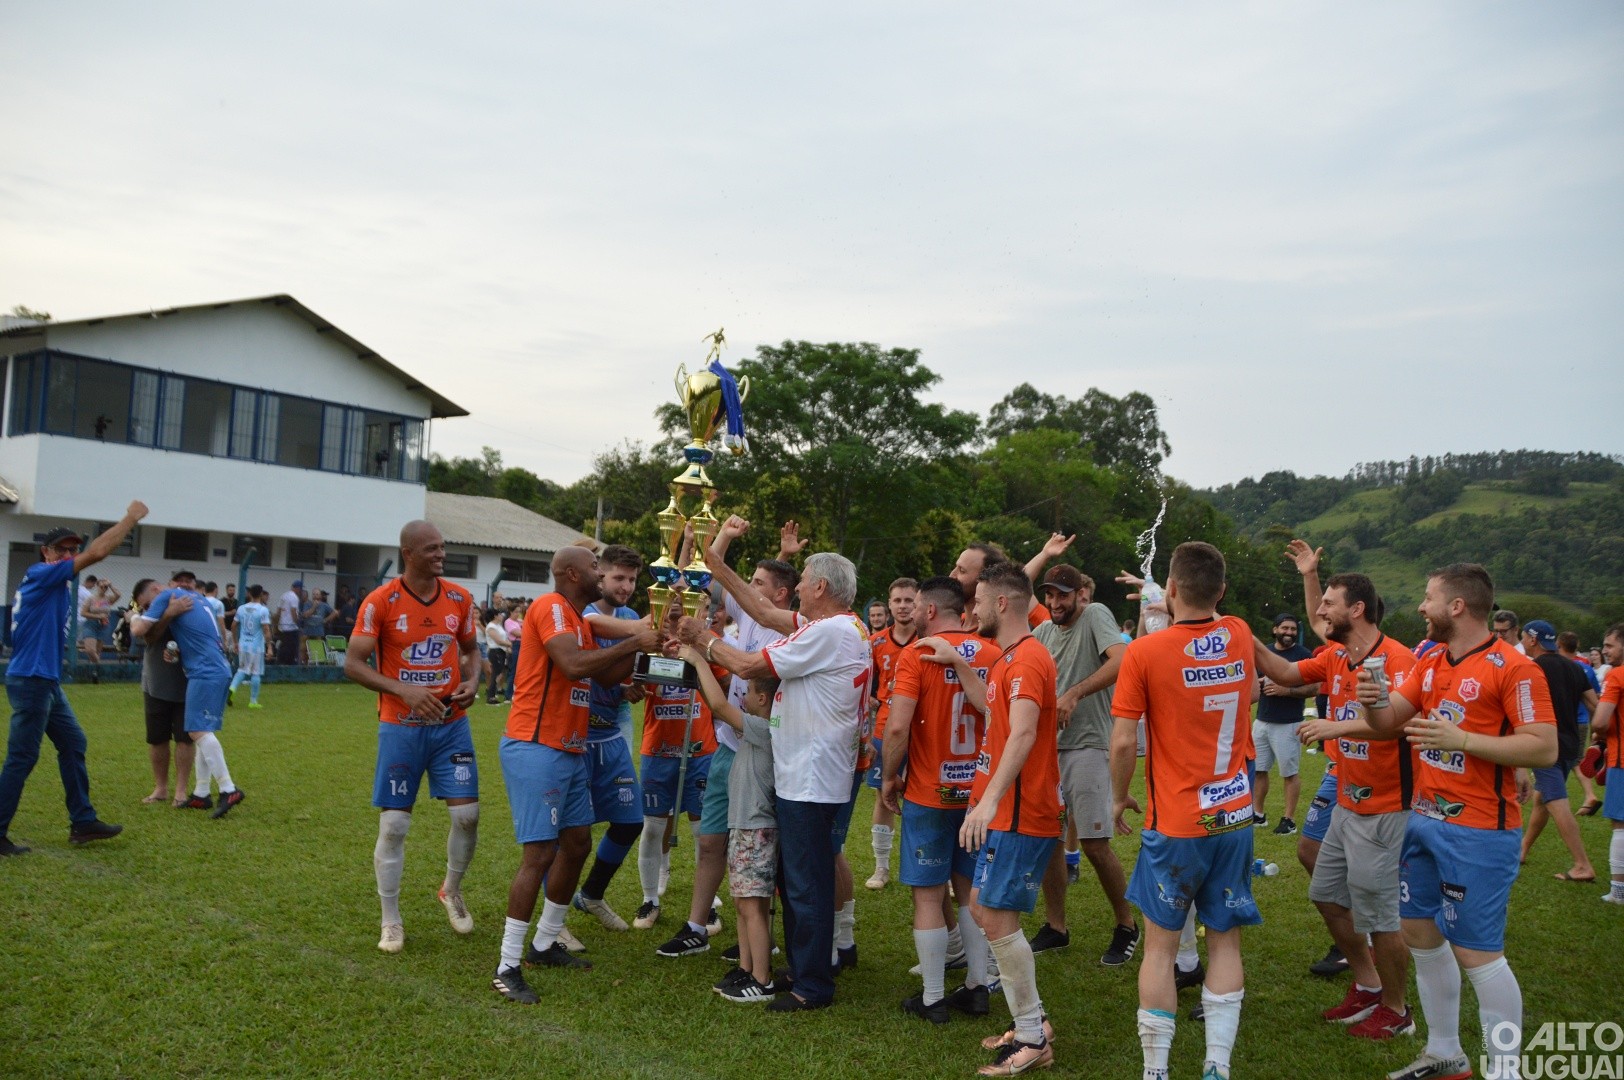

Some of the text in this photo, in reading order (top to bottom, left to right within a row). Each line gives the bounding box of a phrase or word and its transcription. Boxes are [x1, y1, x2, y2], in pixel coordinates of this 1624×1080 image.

[882, 654, 891, 670] 2
[400, 668, 451, 682] DREBOR
[1184, 662, 1243, 682] DREBOR
[949, 691, 977, 756] 6
[1203, 690, 1239, 776] 7
[873, 766, 882, 780] 2
[943, 762, 977, 772] Farmáci
[389, 779, 408, 796] 14
[644, 793, 658, 808] 11
[550, 806, 558, 826] 8
